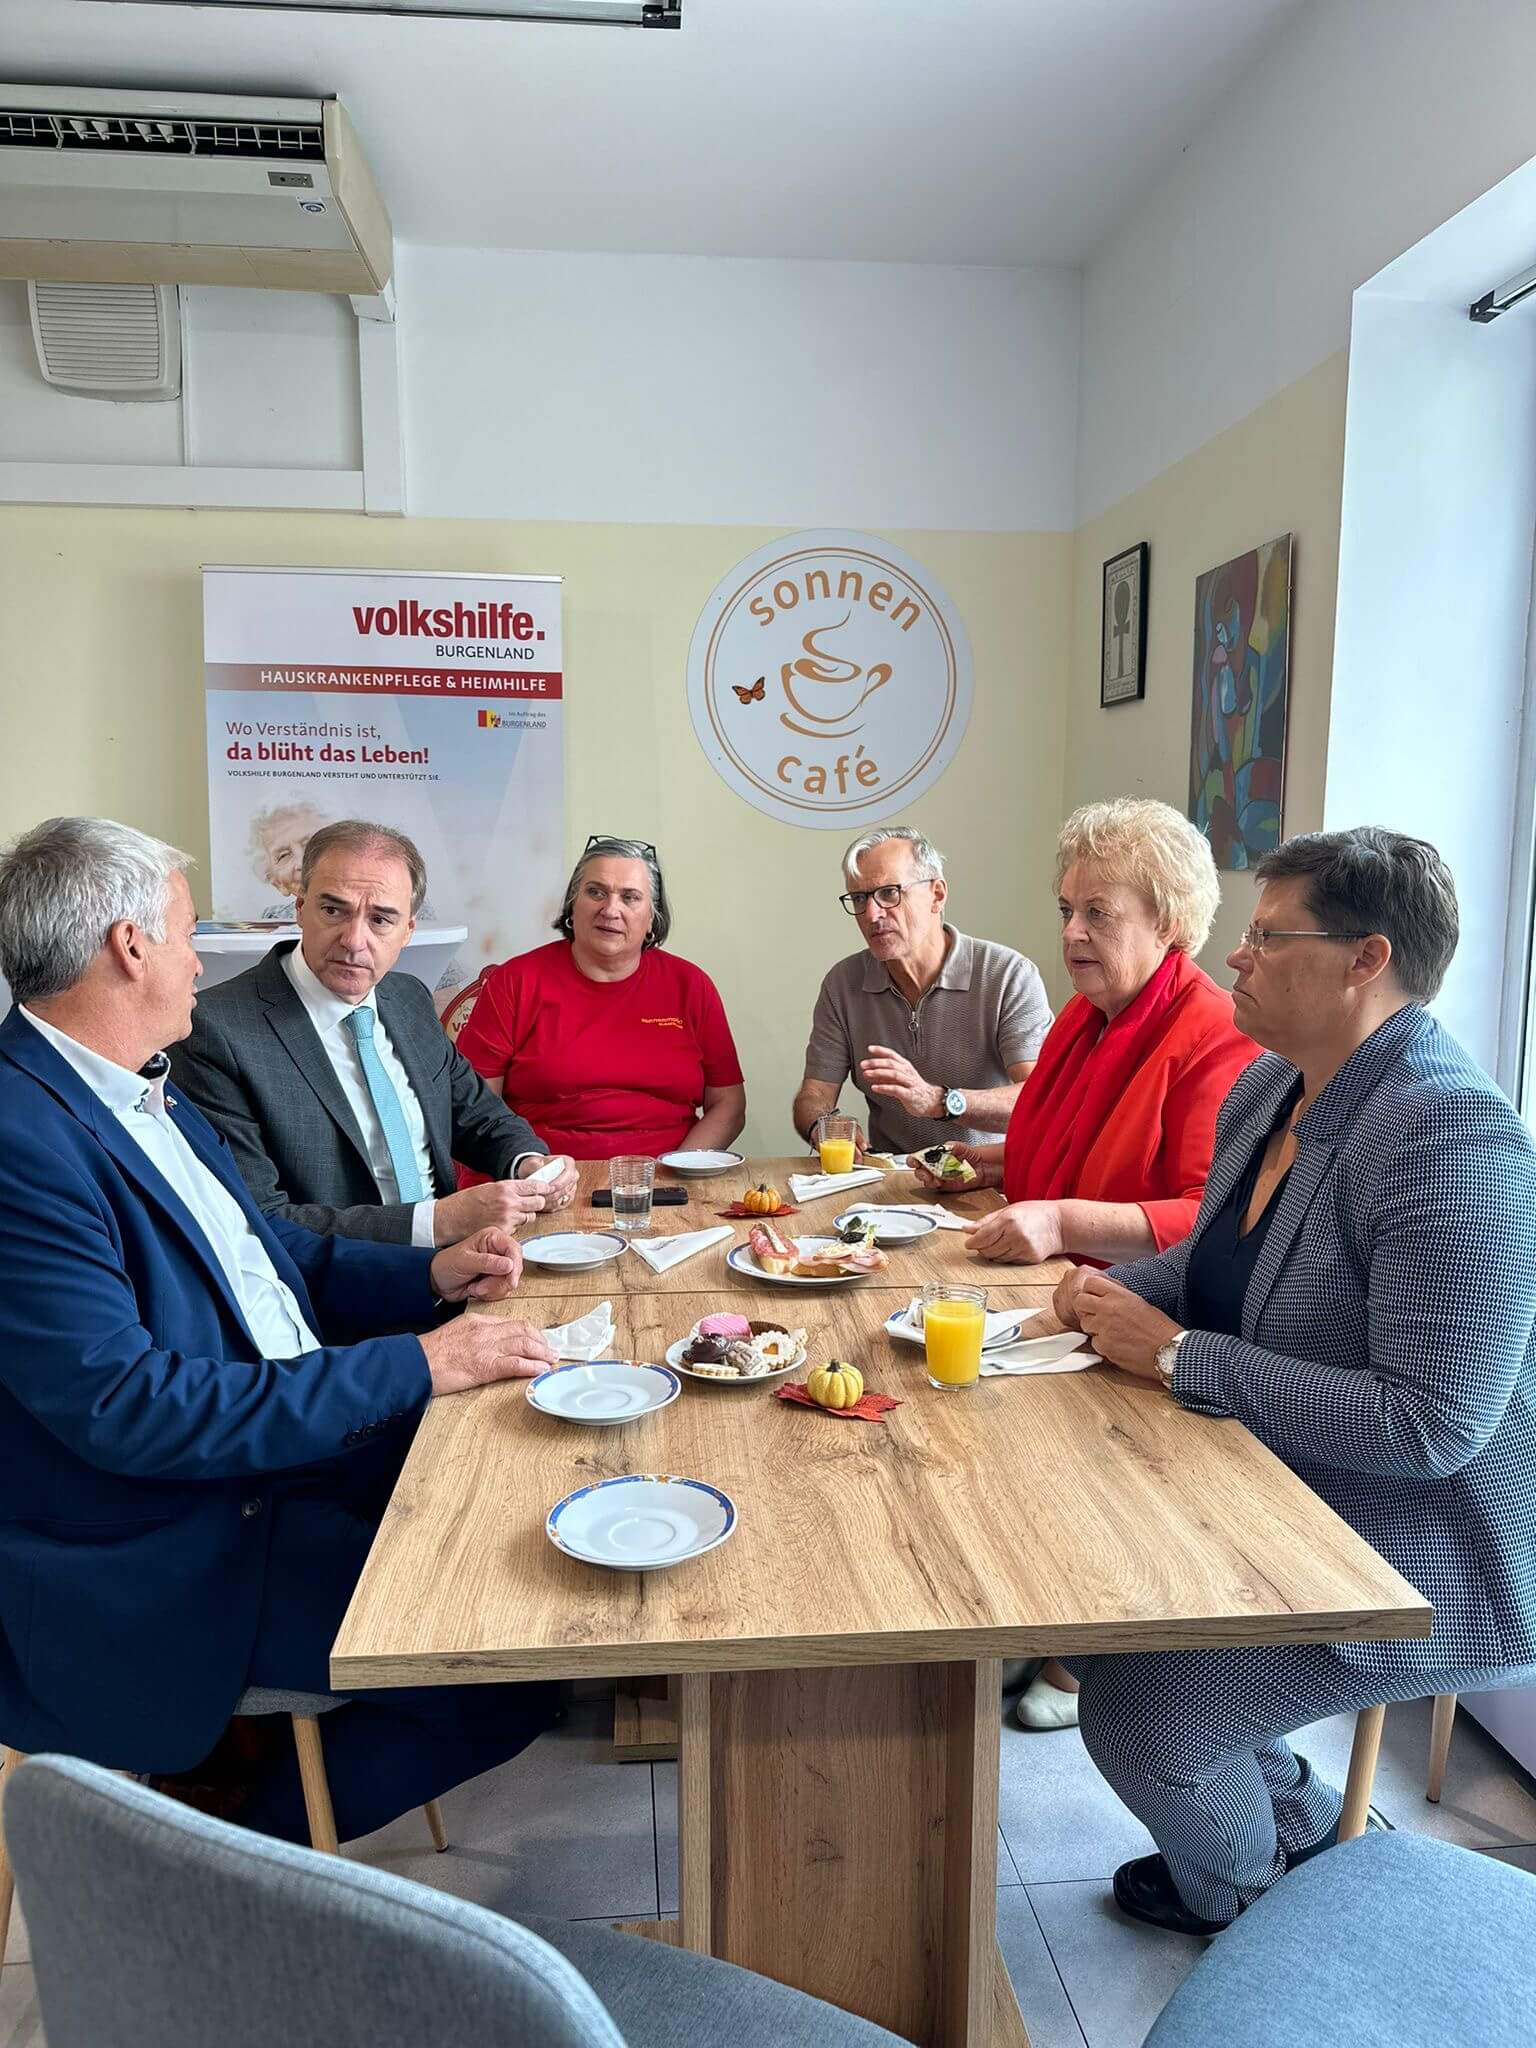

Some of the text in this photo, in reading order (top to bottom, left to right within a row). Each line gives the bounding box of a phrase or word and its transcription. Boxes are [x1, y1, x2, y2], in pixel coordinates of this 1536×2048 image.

[749, 569, 921, 632] sonnen
[352, 599, 546, 641] volkshilfe.
[435, 645, 535, 660] BURGENLAND
[260, 670, 547, 692] HAUSKRANKENPFLEGE & HEIMHILFE
[226, 722, 381, 740] Wo Verständnis ist,
[502, 720, 547, 729] BURGENLAND
[226, 742, 429, 765] da blüht das Leben!
[272, 770, 321, 778] BURGENLAND
[777, 744, 881, 795] café
